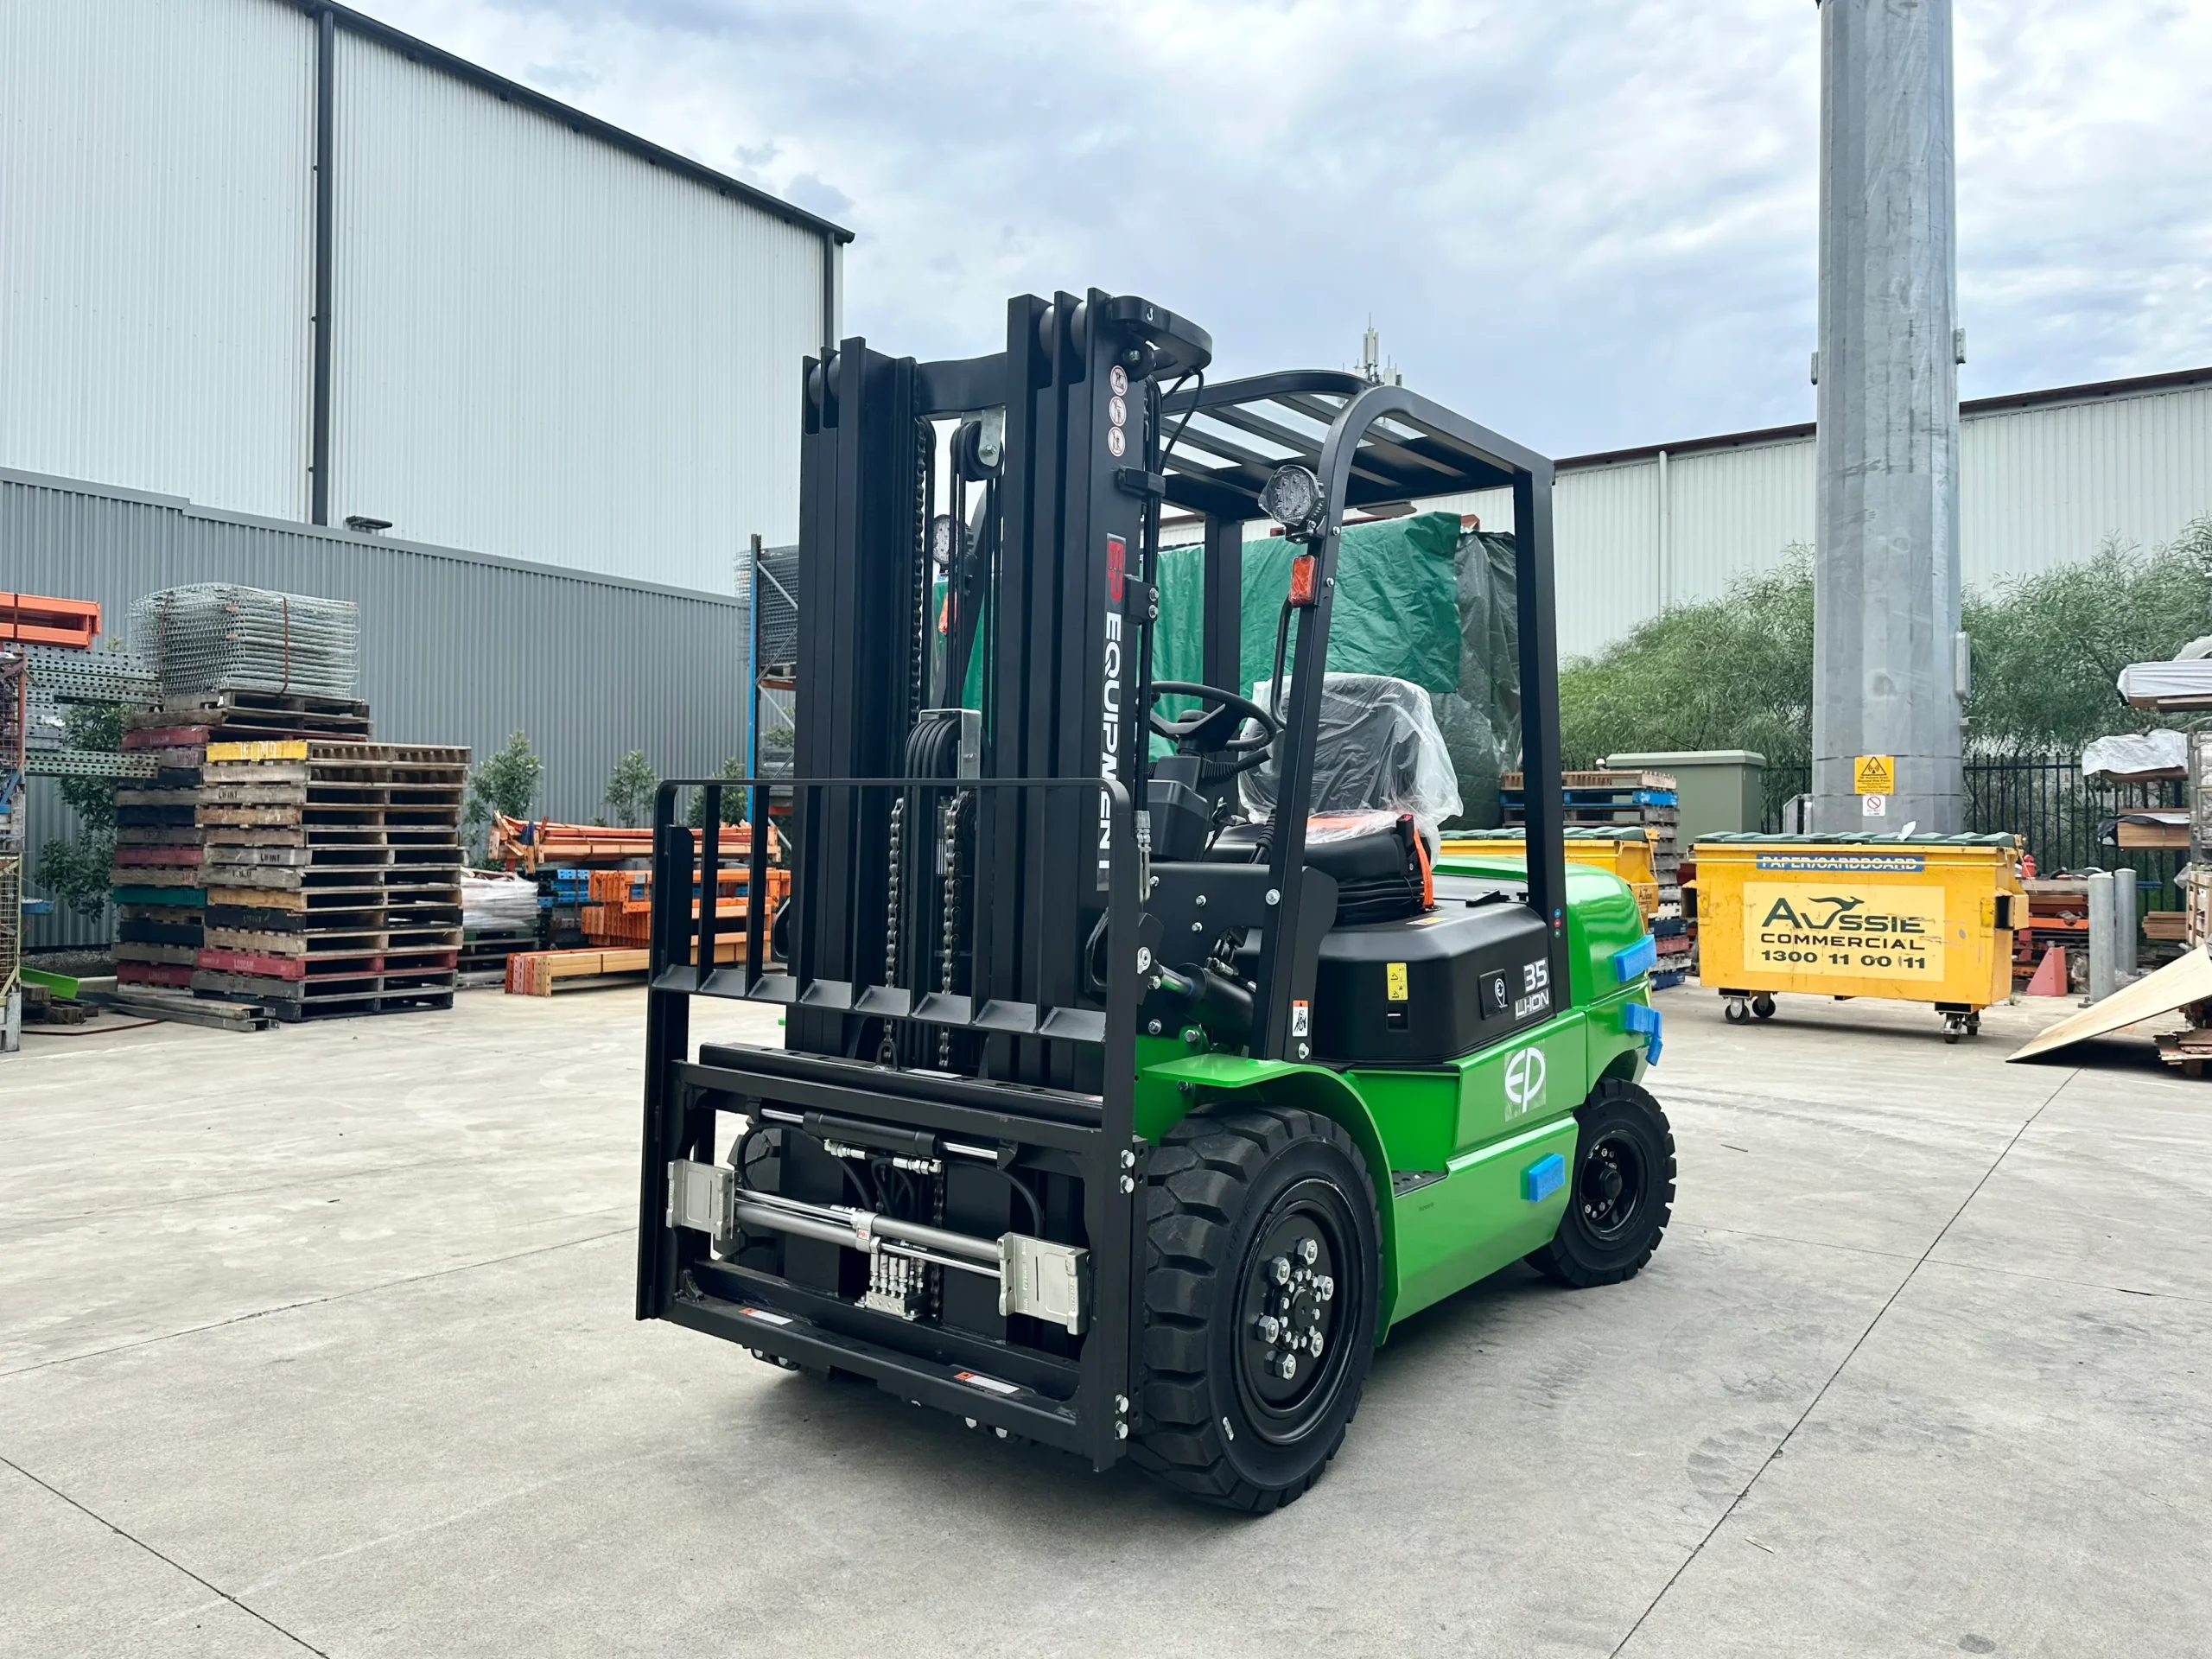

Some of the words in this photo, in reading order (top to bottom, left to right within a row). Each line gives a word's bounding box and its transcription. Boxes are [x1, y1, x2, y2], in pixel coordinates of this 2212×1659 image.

[1761, 933, 1926, 950] COMMERCIAL
[1761, 950, 1818, 963] 1300
[1828, 953, 1850, 965] 11
[1860, 955, 1892, 968] 00
[1904, 957, 1926, 969] 11
[1524, 959, 1548, 992] 35
[1505, 1047, 1546, 1114] EP
